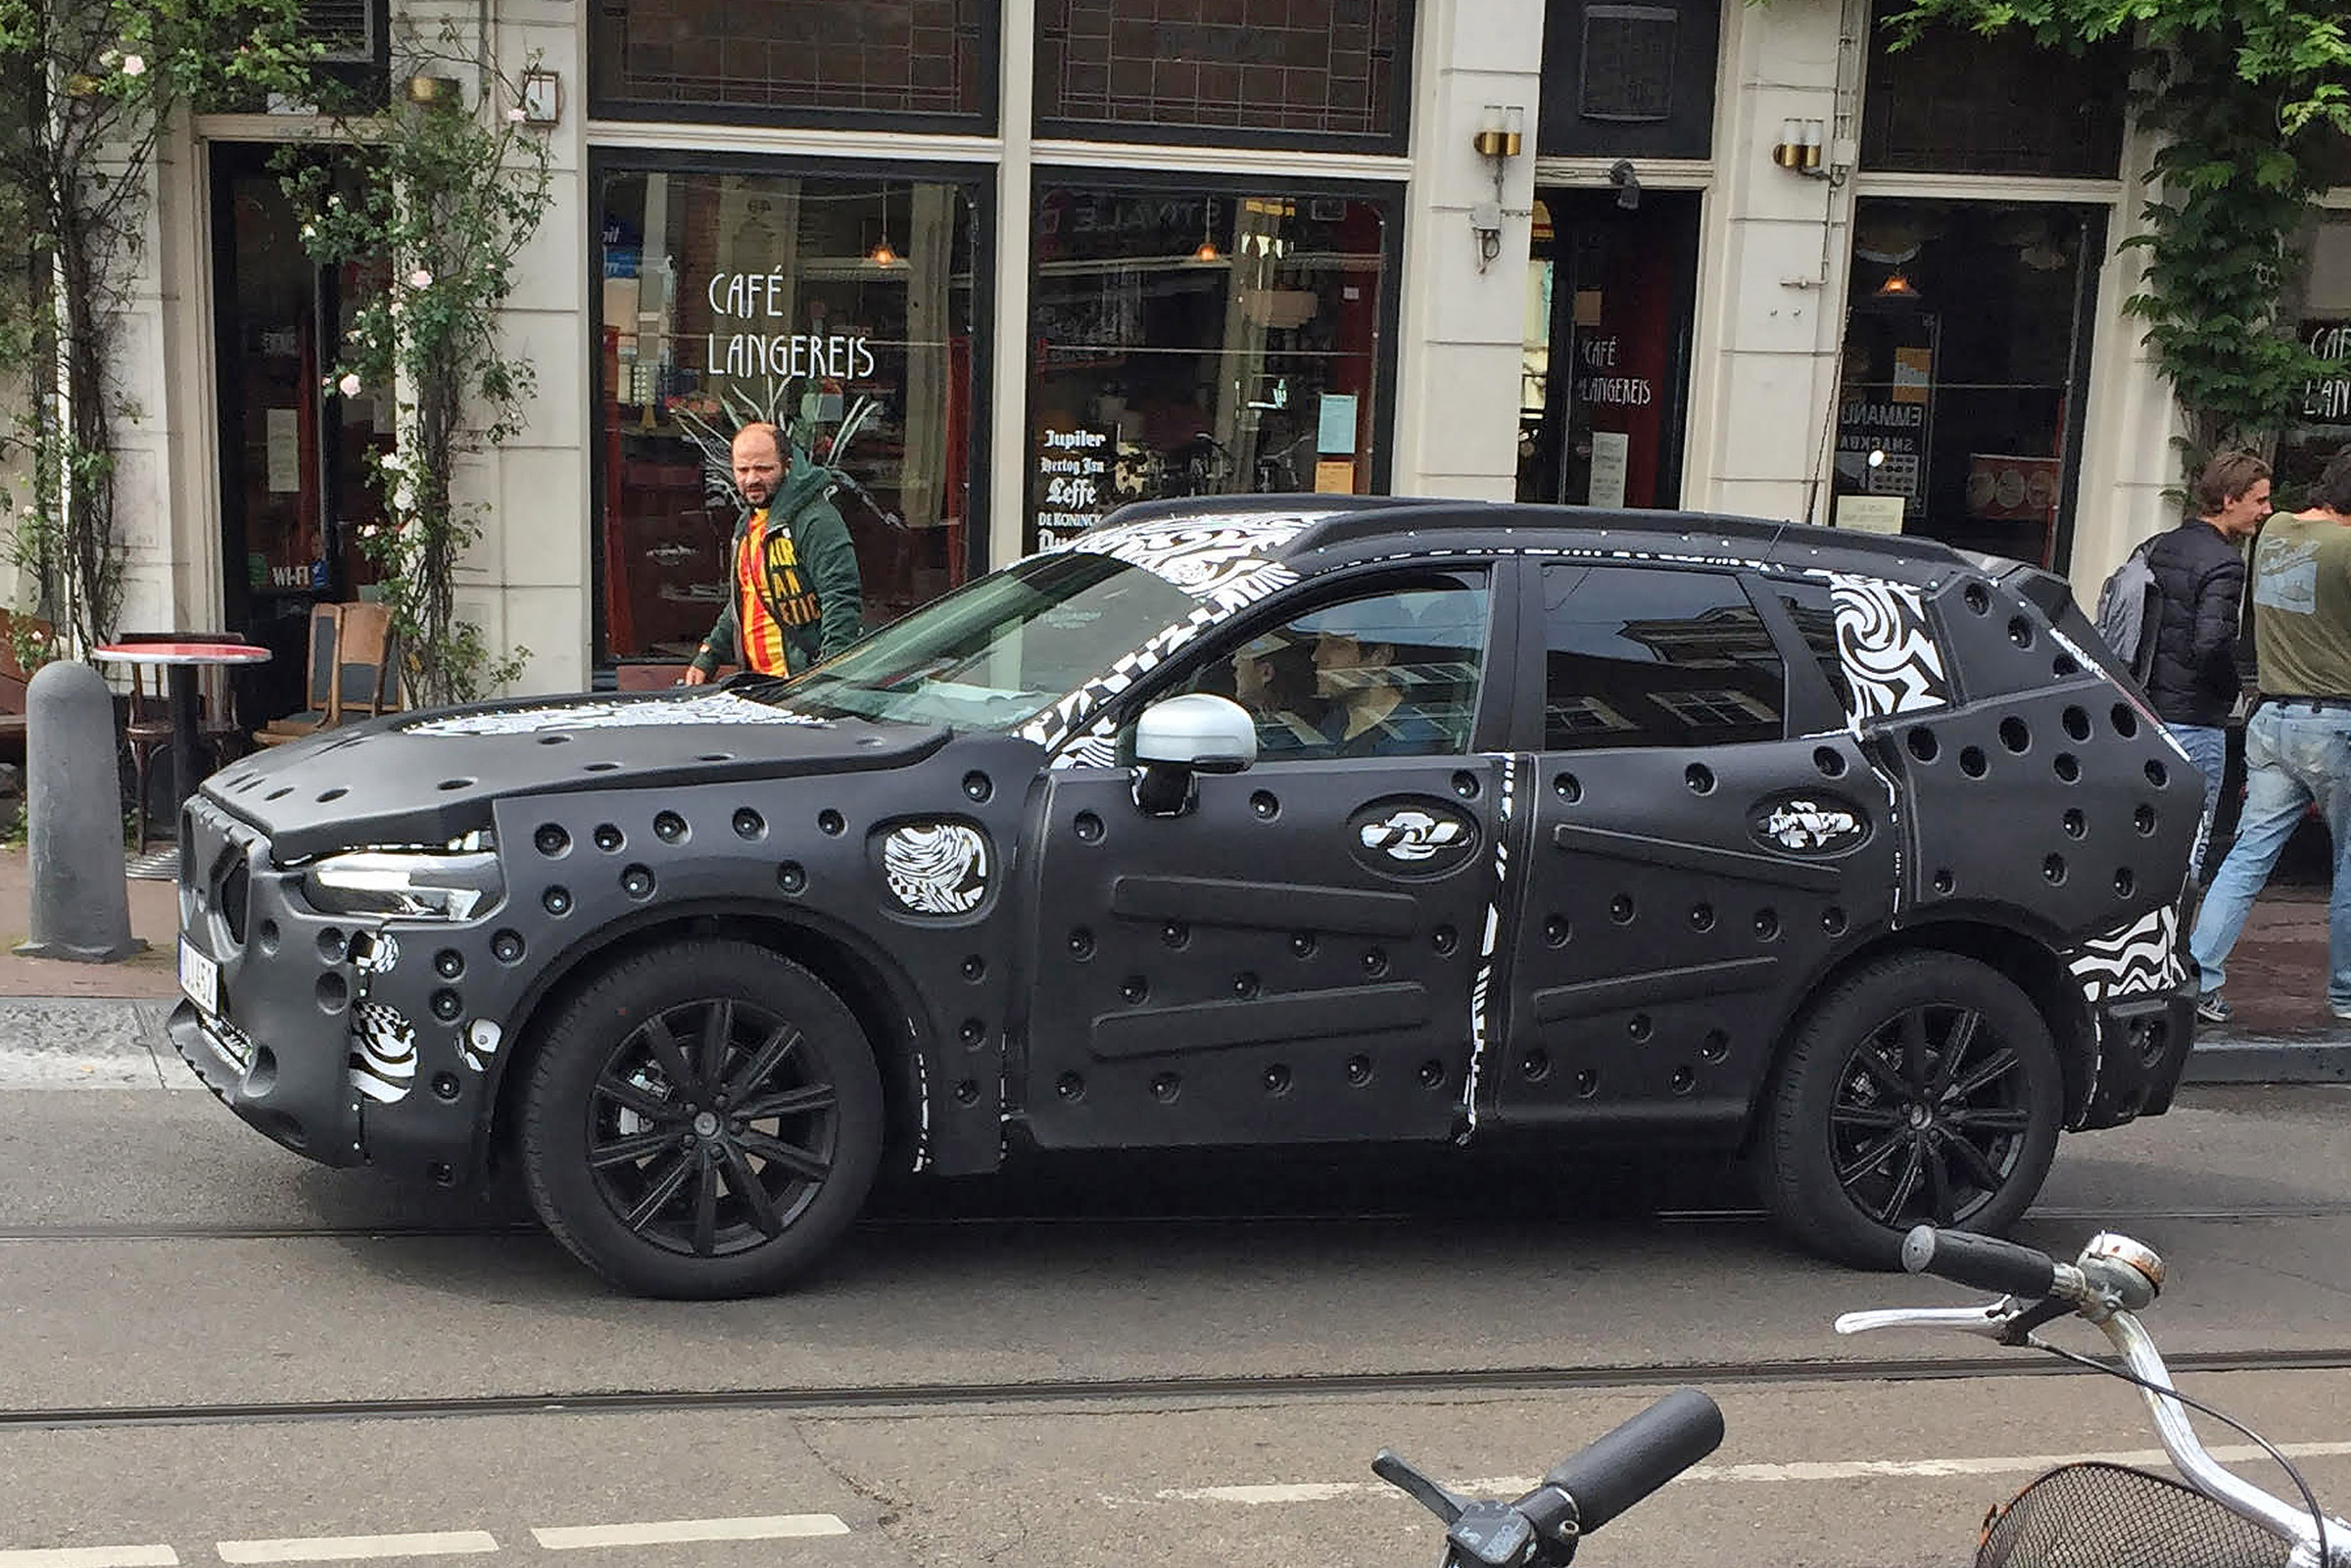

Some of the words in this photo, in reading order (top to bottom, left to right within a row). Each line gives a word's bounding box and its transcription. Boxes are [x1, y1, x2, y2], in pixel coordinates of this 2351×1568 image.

[708, 264, 784, 318] CAFÉ
[708, 333, 875, 380] LANGEREIS
[1584, 335, 1616, 367] CAFÉ
[1582, 378, 1652, 405] LANGEREIS
[1043, 429, 1107, 451] Jupiler
[1039, 456, 1080, 476] Hertog
[1081, 456, 1105, 475] Jan
[1045, 477, 1097, 509] Leffe
[271, 565, 310, 587] WI-FI
